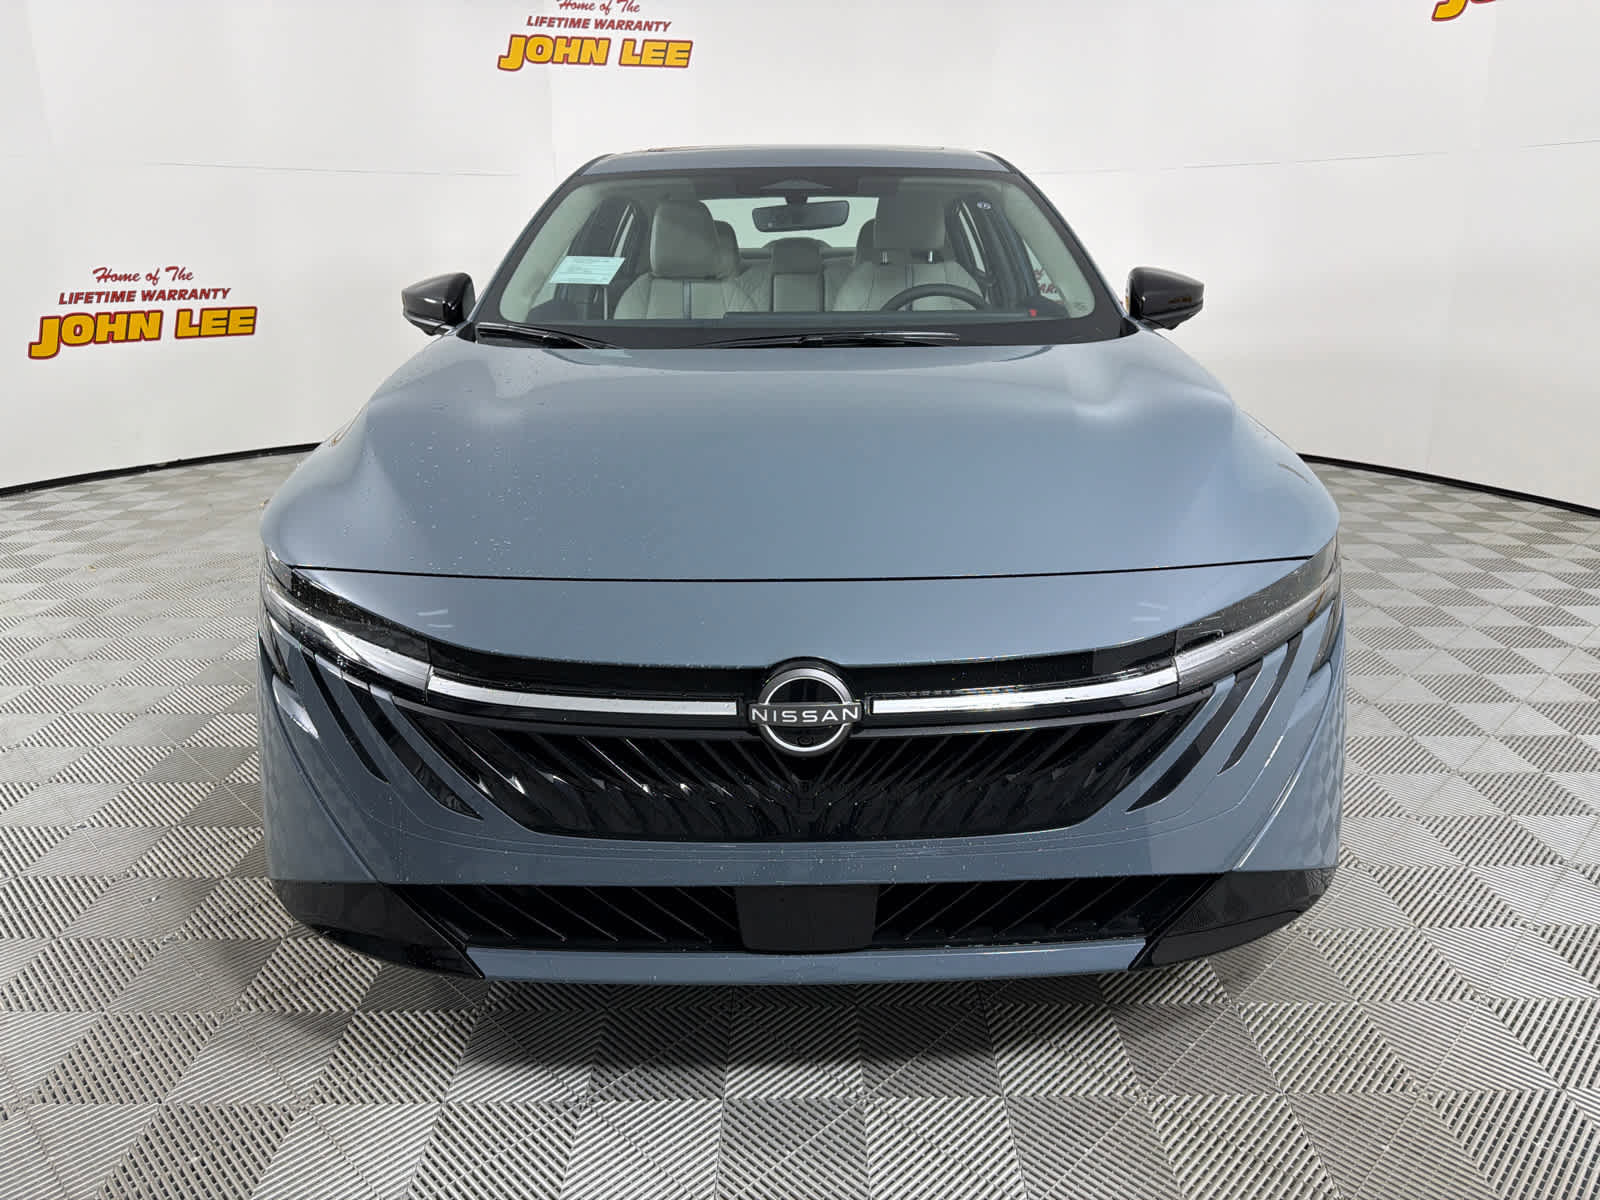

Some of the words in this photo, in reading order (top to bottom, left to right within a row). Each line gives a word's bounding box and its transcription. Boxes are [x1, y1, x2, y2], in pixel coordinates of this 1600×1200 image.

[556, 0, 595, 10] Home
[600, 0, 612, 15] of
[617, 0, 641, 12] The
[526, 16, 591, 29] LIFETIME
[594, 19, 672, 32] WARRANTY
[497, 34, 611, 71] JOHN
[618, 38, 693, 68] LEE
[92, 267, 141, 283] Home
[145, 268, 161, 285] of
[165, 266, 194, 281] The
[58, 290, 136, 305] LIFETIME
[141, 288, 231, 302] WARRANTY
[28, 310, 163, 360] JOHN
[175, 306, 257, 339] LEE
[752, 706, 858, 723] NISSAN
